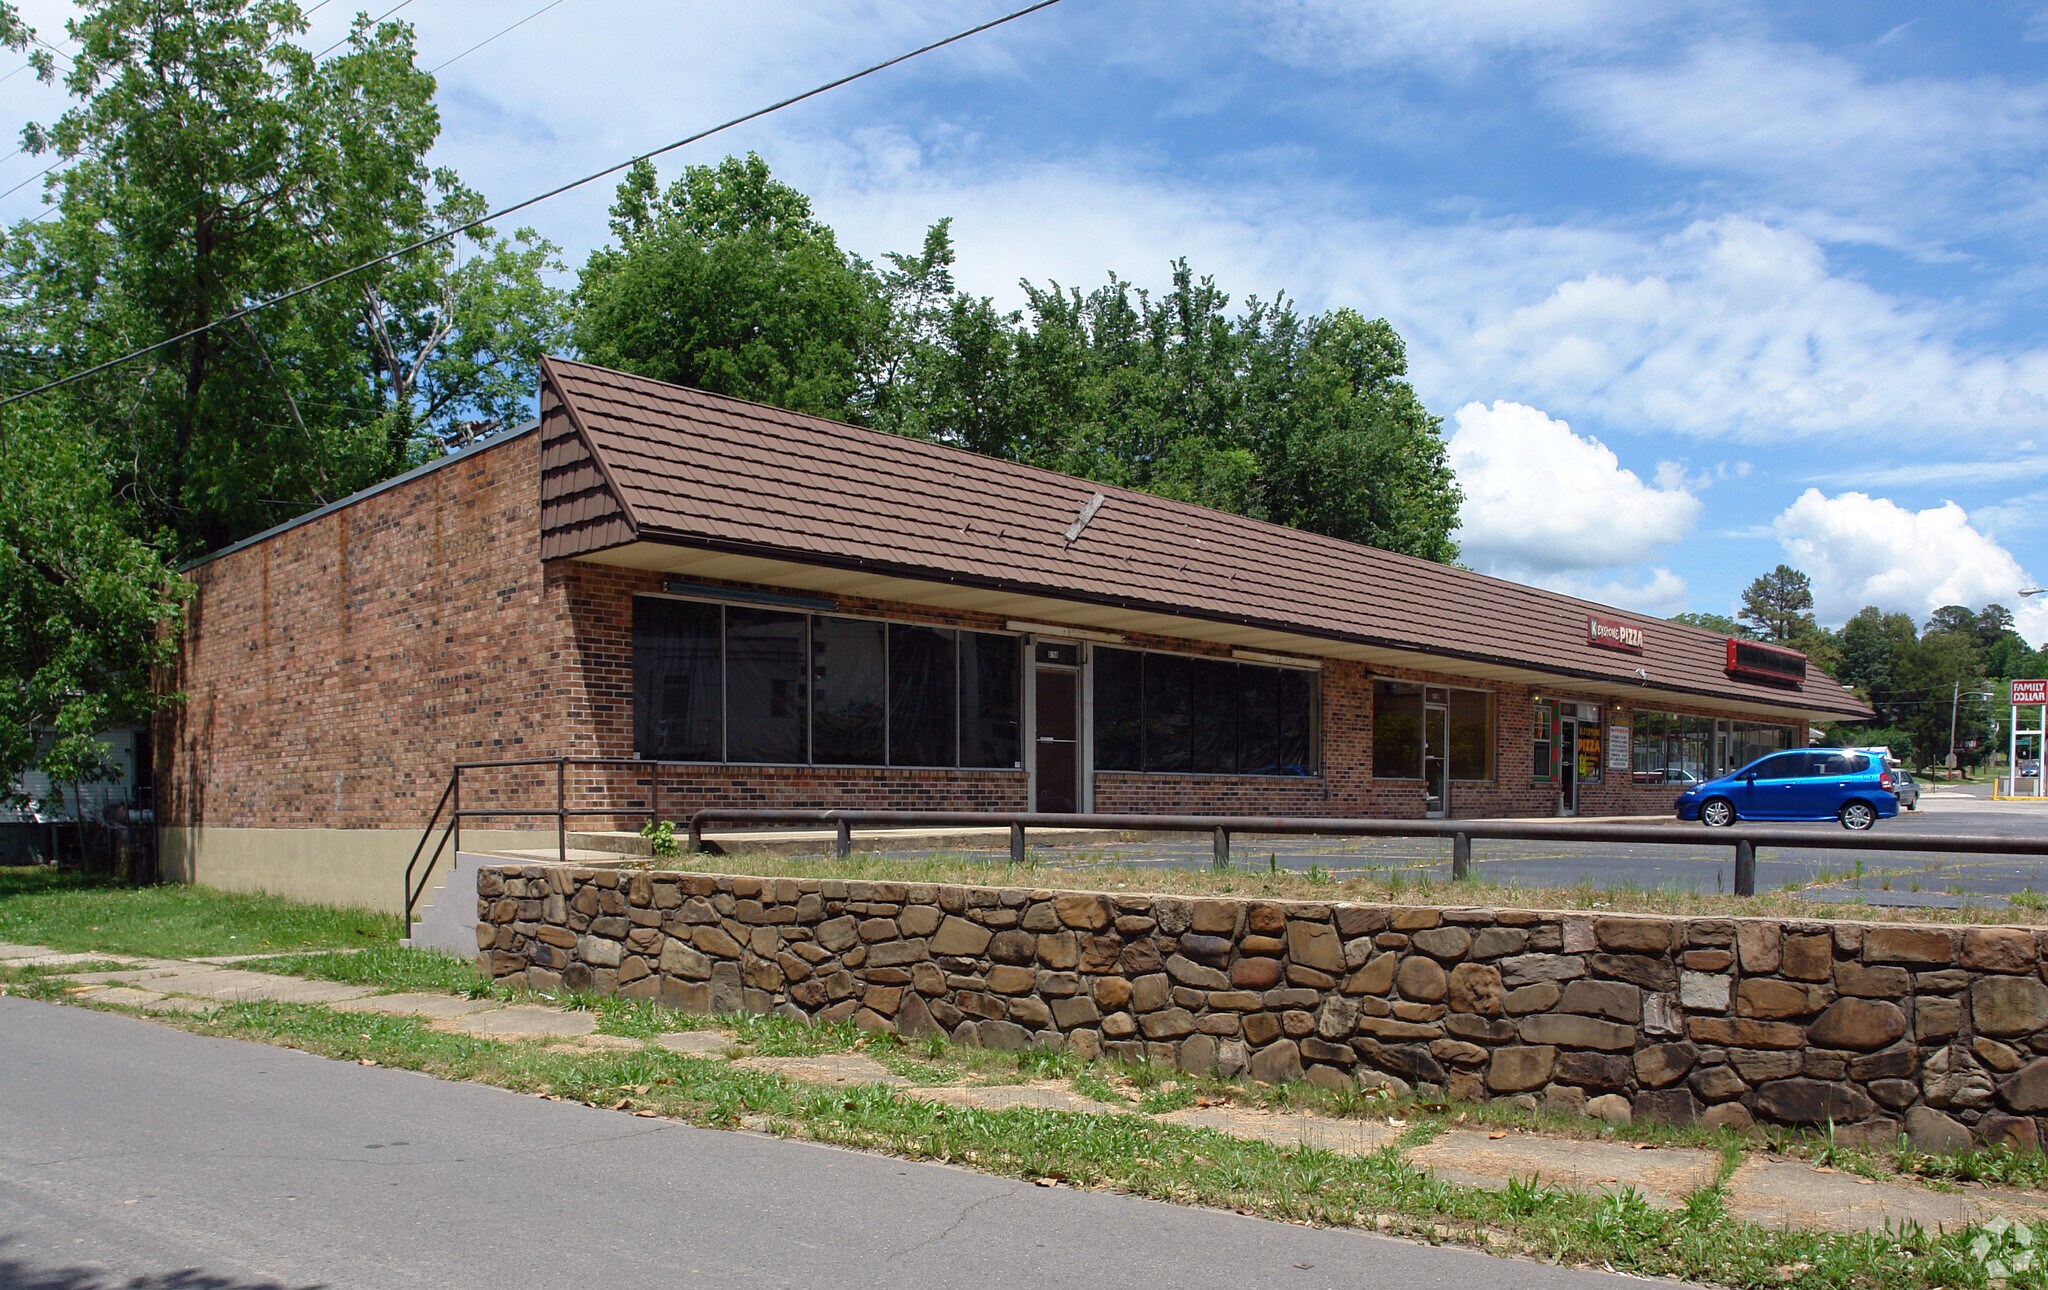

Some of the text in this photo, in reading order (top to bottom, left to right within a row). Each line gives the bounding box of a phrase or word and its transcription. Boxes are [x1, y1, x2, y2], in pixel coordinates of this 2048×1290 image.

[1619, 626, 1643, 648] PIZZA
[2013, 682, 2045, 691] FAMILY
[2013, 692, 2045, 702] DOLLAR
[1578, 738, 1601, 753] PIZZA
